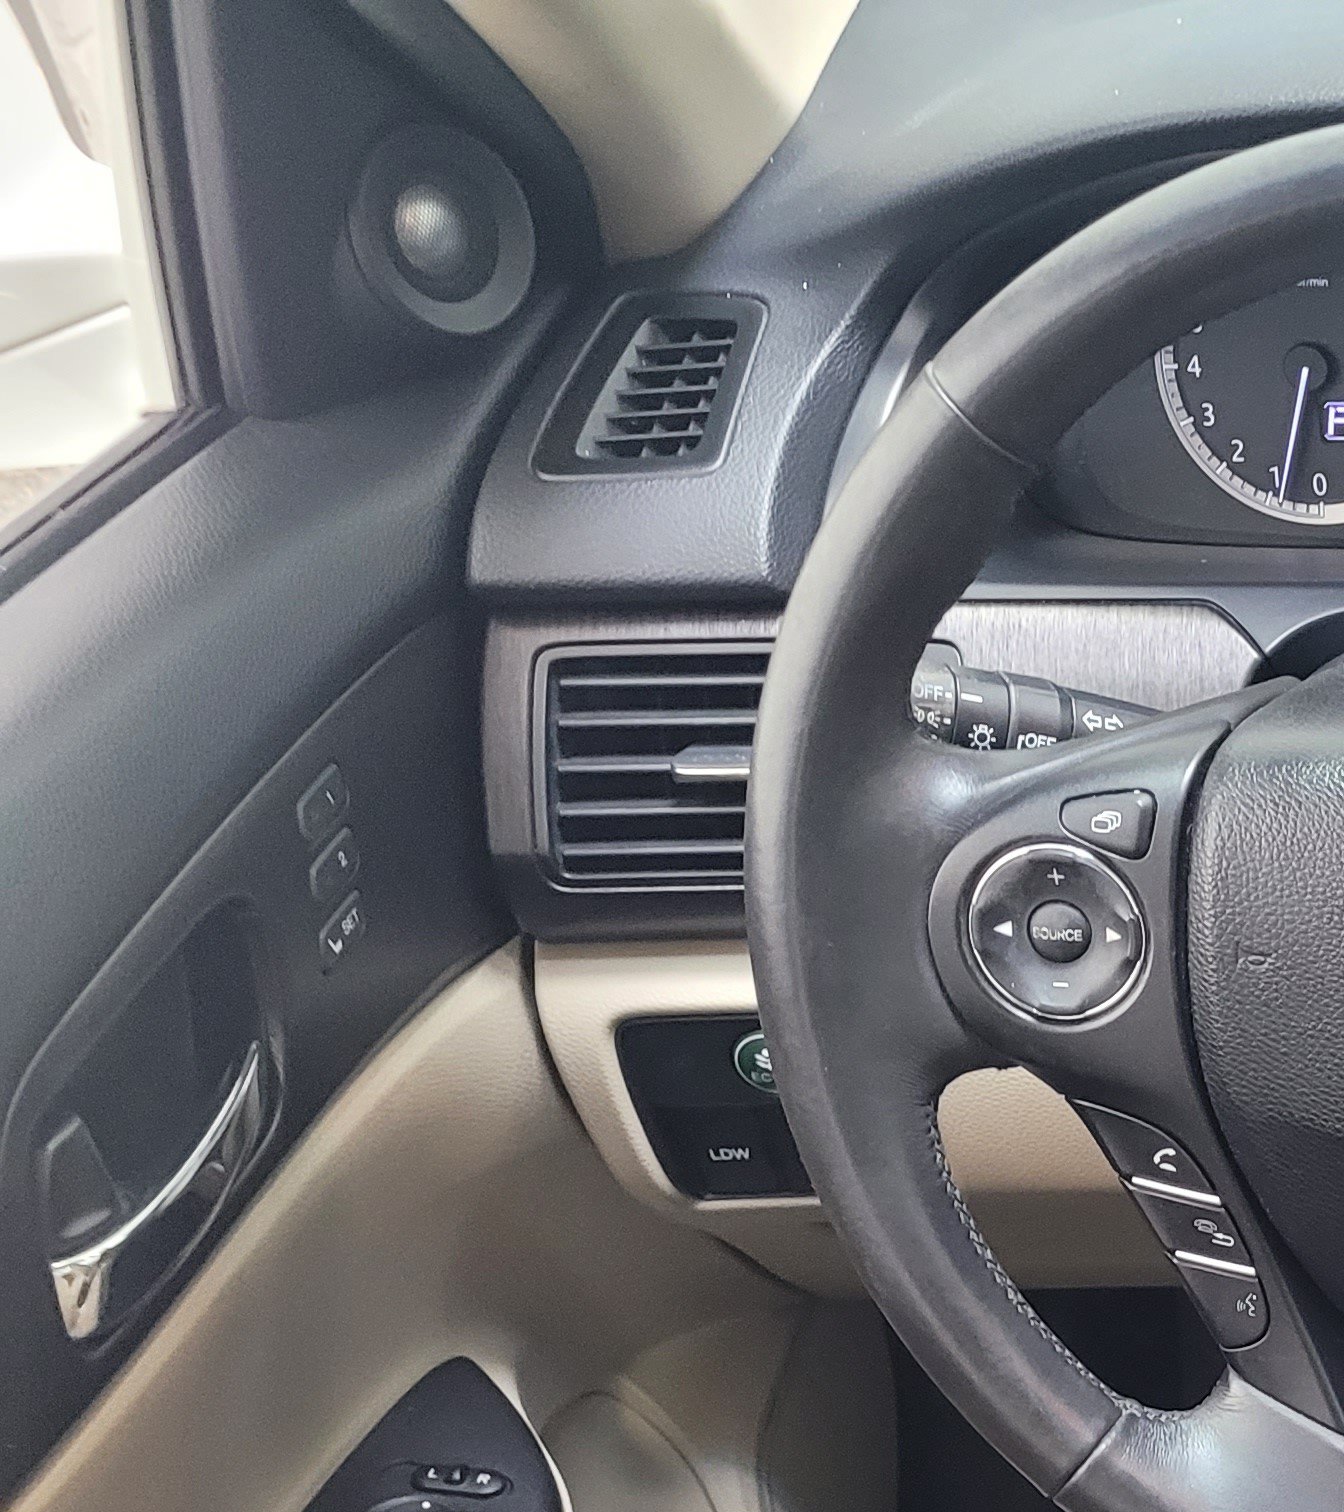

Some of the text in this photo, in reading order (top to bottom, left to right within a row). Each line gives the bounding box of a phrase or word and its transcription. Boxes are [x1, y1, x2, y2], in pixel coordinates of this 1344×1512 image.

[1187, 354, 1202, 378] 4
[1201, 403, 1215, 427] 3
[1230, 439, 1245, 463] 2
[1269, 465, 1280, 488] 1
[1312, 472, 1327, 496] 0
[342, 907, 360, 935] SET
[1033, 926, 1083, 942] SOURCE
[709, 1148, 750, 1161] LDW
